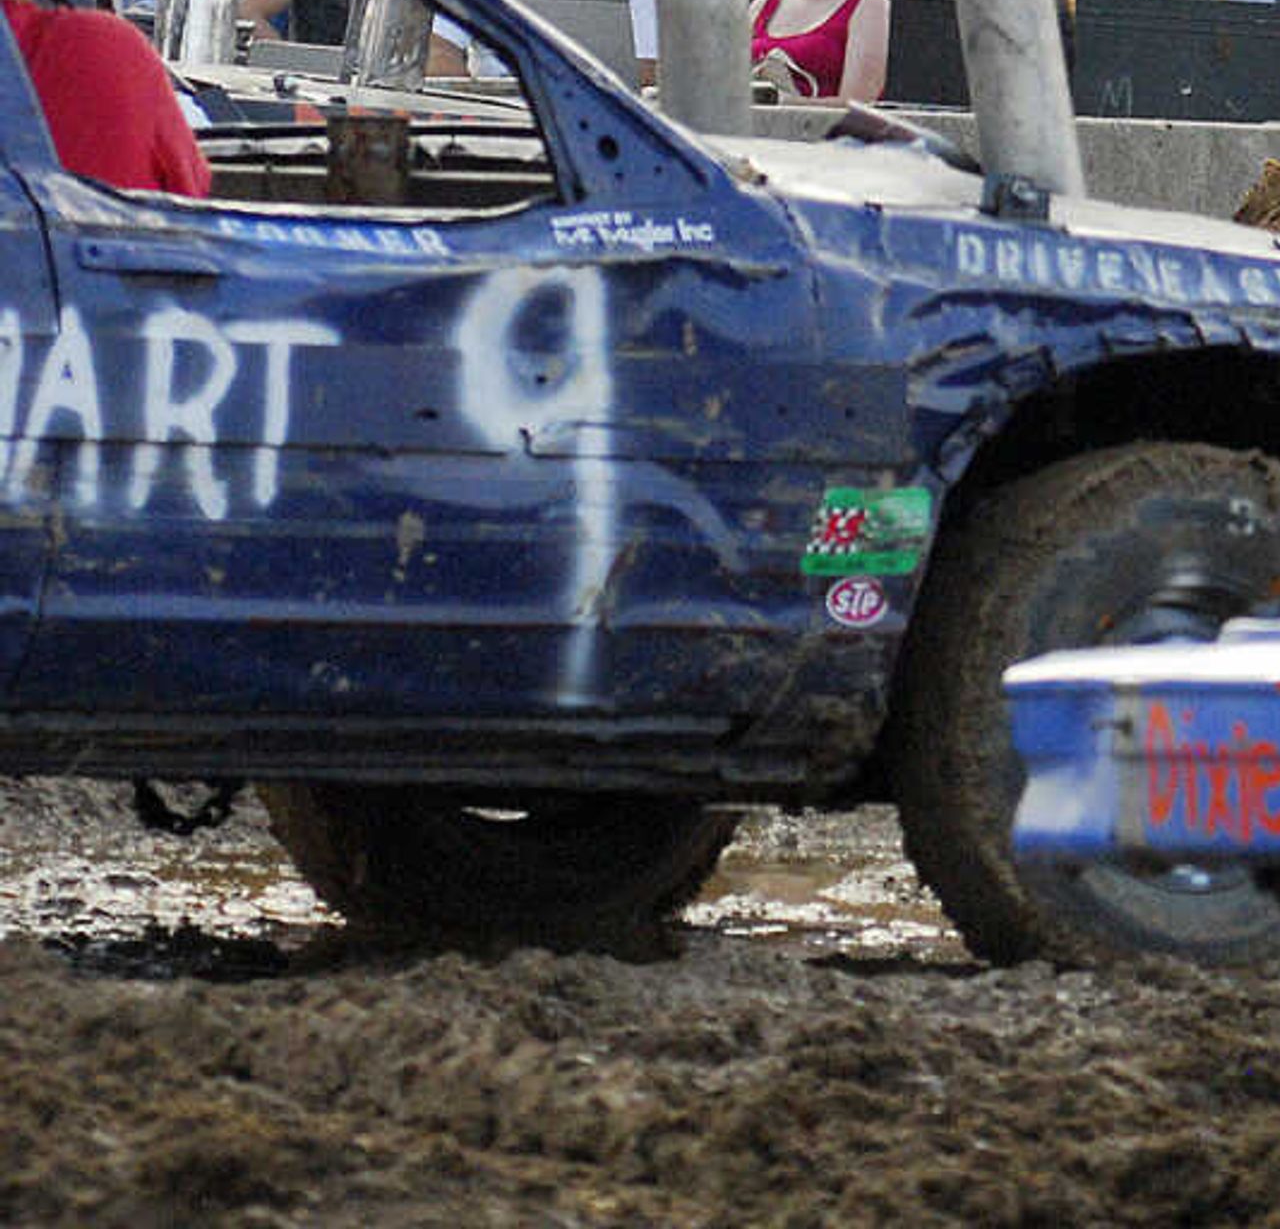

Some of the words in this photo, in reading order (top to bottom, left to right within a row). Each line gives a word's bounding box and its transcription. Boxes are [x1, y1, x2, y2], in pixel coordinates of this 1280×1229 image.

[0, 304, 342, 522] ART
[452, 259, 616, 706] 9
[833, 582, 879, 616] STP
